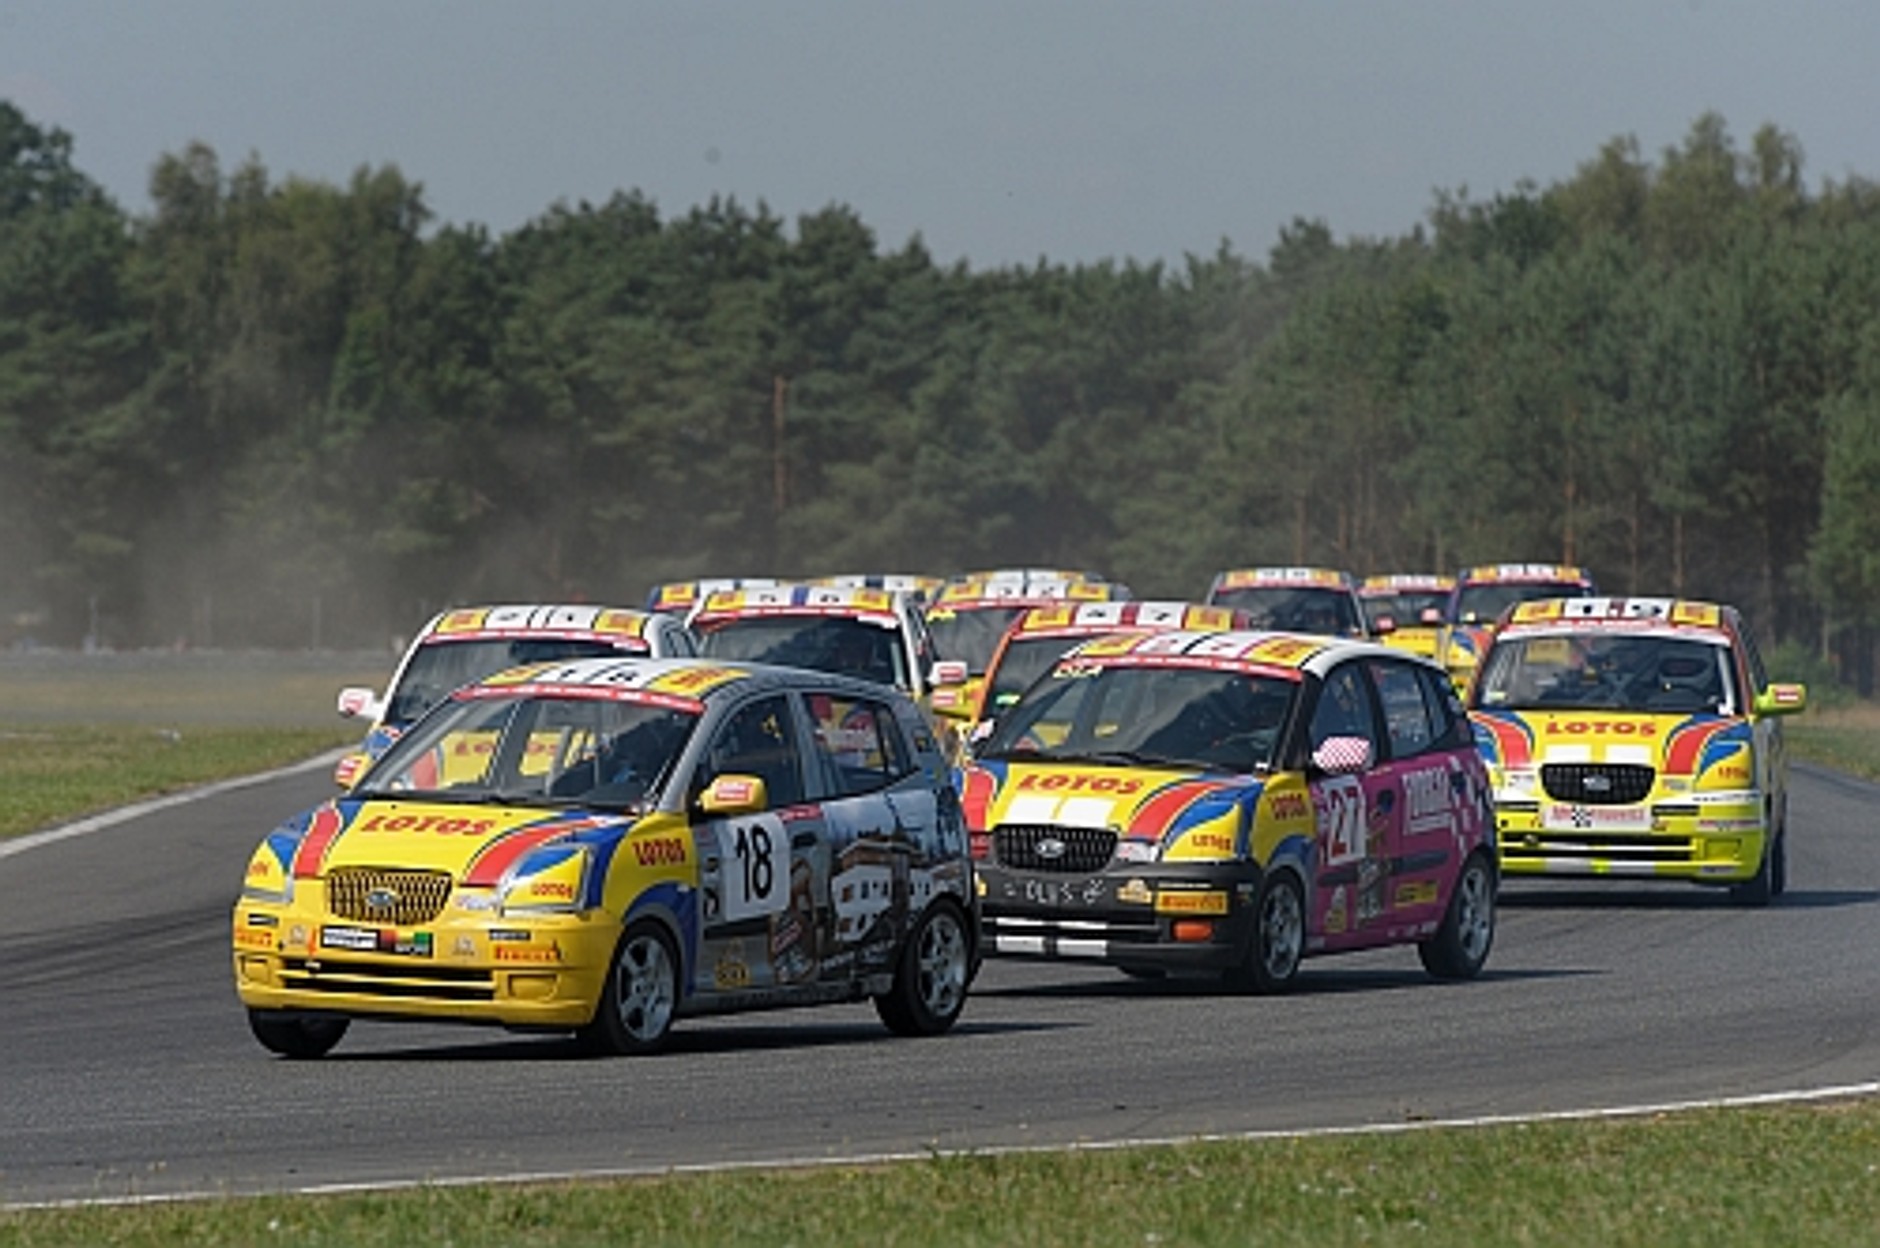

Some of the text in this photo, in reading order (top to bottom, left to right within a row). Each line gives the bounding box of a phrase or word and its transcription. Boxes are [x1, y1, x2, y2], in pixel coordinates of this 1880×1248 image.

[1546, 722, 1657, 737] LOTOS
[1017, 774, 1145, 795] LOTOS
[361, 815, 496, 836] LOTOS
[1330, 786, 1360, 857] 27
[632, 836, 686, 866] LOTOS
[736, 824, 773, 903] 18
